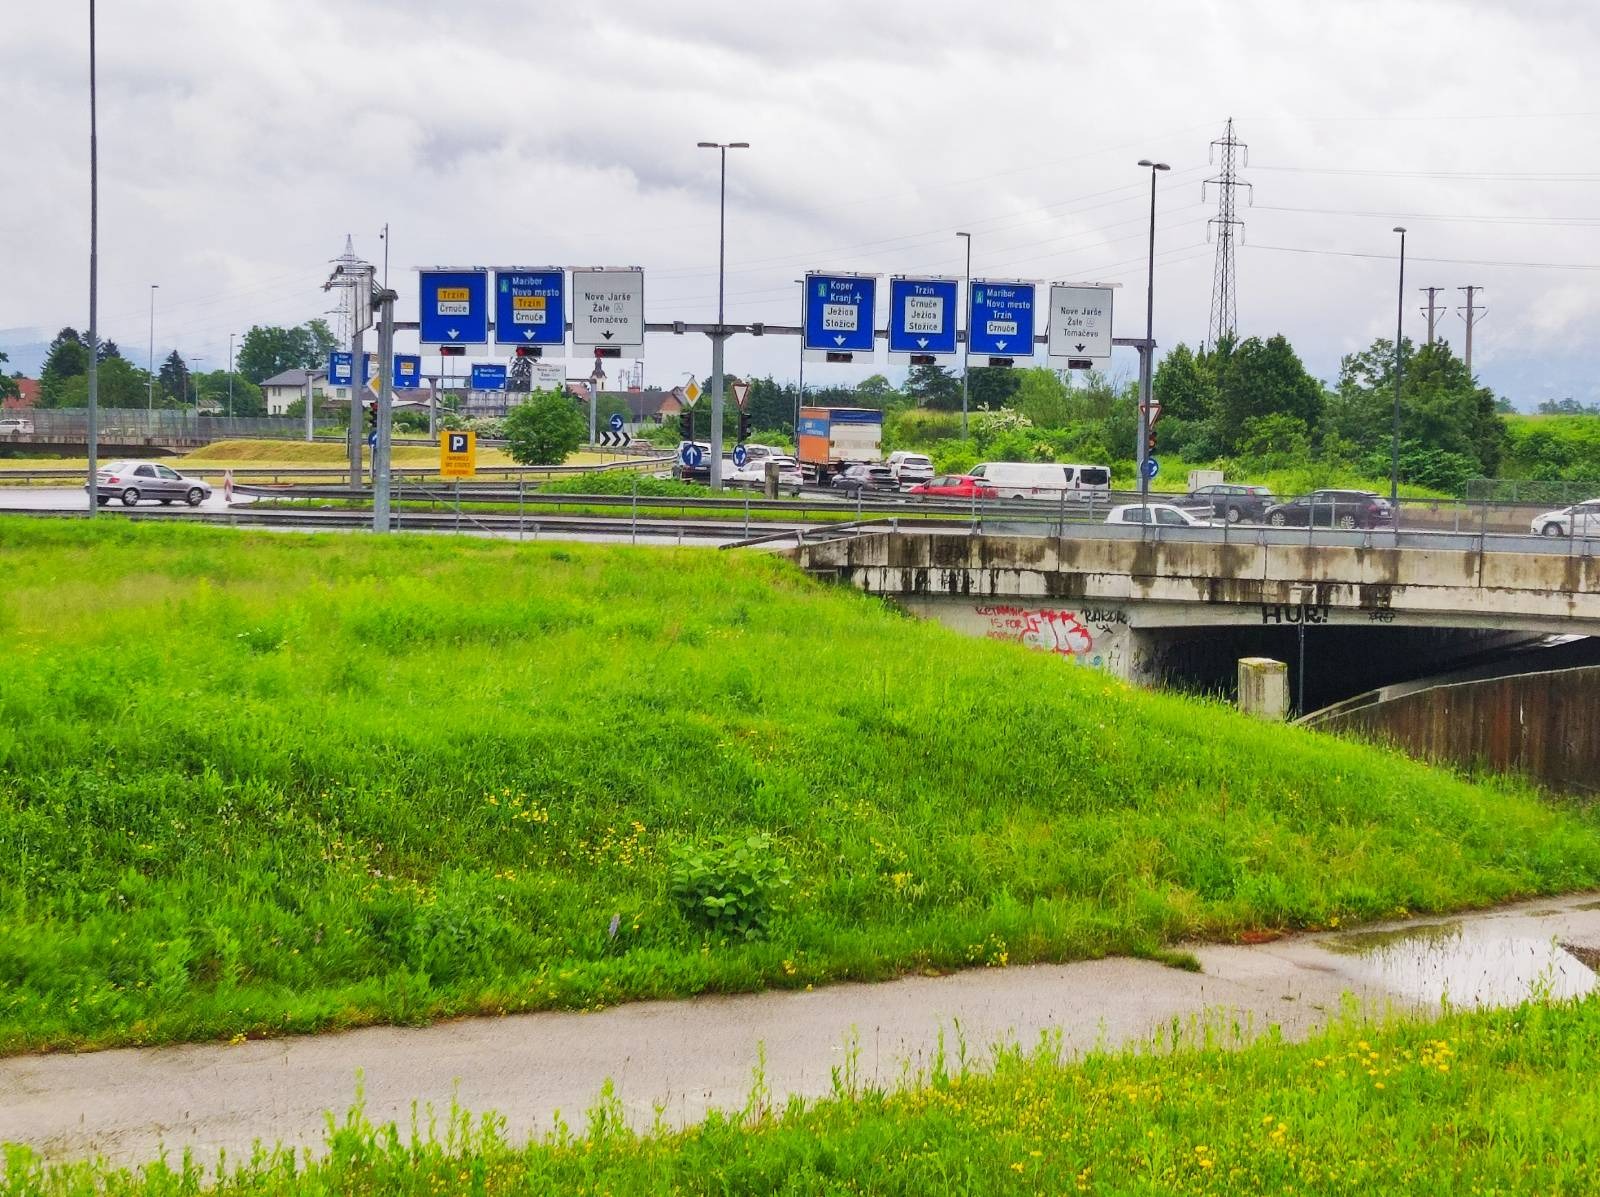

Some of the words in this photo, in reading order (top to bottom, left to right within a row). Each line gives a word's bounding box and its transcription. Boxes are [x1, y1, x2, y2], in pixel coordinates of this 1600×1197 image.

[512, 277, 543, 286] Maribor
[830, 280, 854, 291] Koper
[442, 290, 465, 299] Trzin
[512, 288, 530, 297] Novo
[534, 288, 560, 297] mesto
[914, 285, 935, 295] Trzin
[986, 288, 1016, 298] Maribor
[584, 292, 605, 301] Nove
[830, 292, 852, 304] Kranj
[439, 301, 467, 313] Črnuče
[518, 298, 541, 308] Trzin
[910, 297, 937, 308] Črnuče
[986, 299, 1005, 308] Novo
[1007, 300, 1031, 310] mesto
[515, 310, 544, 322] Črnuče
[993, 310, 1012, 319] Trzin
[1060, 306, 1079, 316] Nove
[988, 322, 1015, 334] Črnuče
[453, 436, 464, 451] P
[1262, 605, 1329, 624] HUR!
